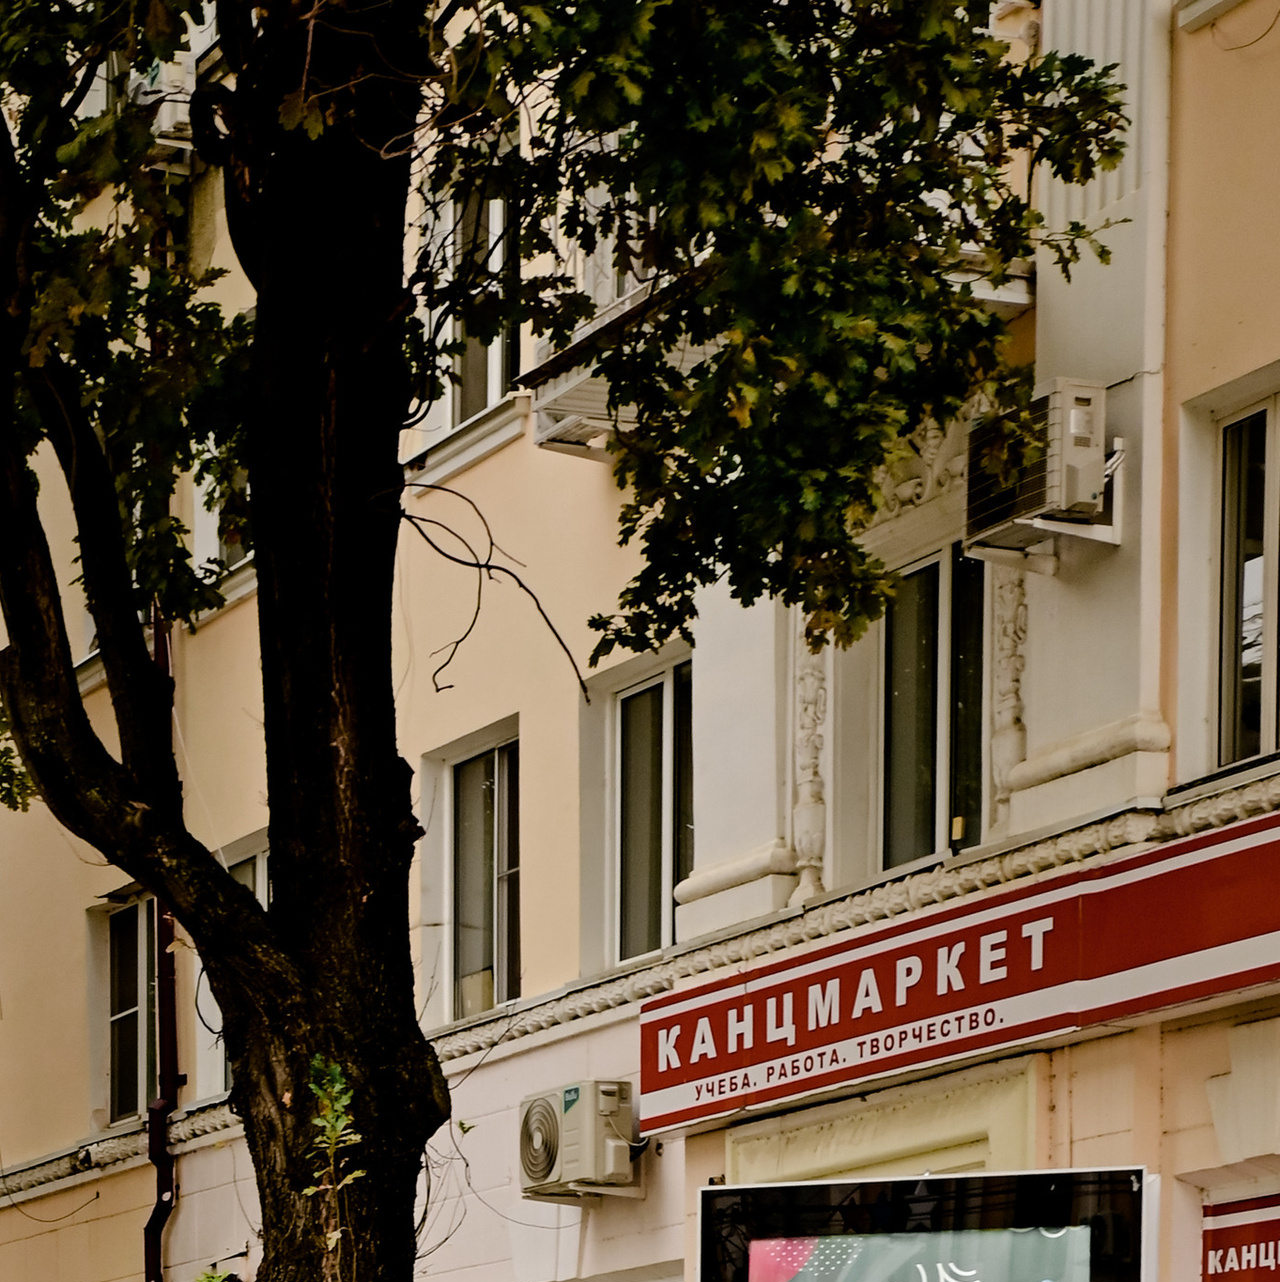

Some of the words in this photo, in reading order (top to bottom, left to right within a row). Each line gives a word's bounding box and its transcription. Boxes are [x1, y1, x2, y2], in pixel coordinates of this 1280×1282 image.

[656, 916, 1055, 1074] КАНЦМАРКЕТ
[694, 1073, 758, 1102] УЧЕБА.
[766, 1047, 848, 1084] РАБОТА.
[856, 1007, 1006, 1059] ТВОРЧЕСТВО.
[1207, 1239, 1280, 1275] КАНЦ
